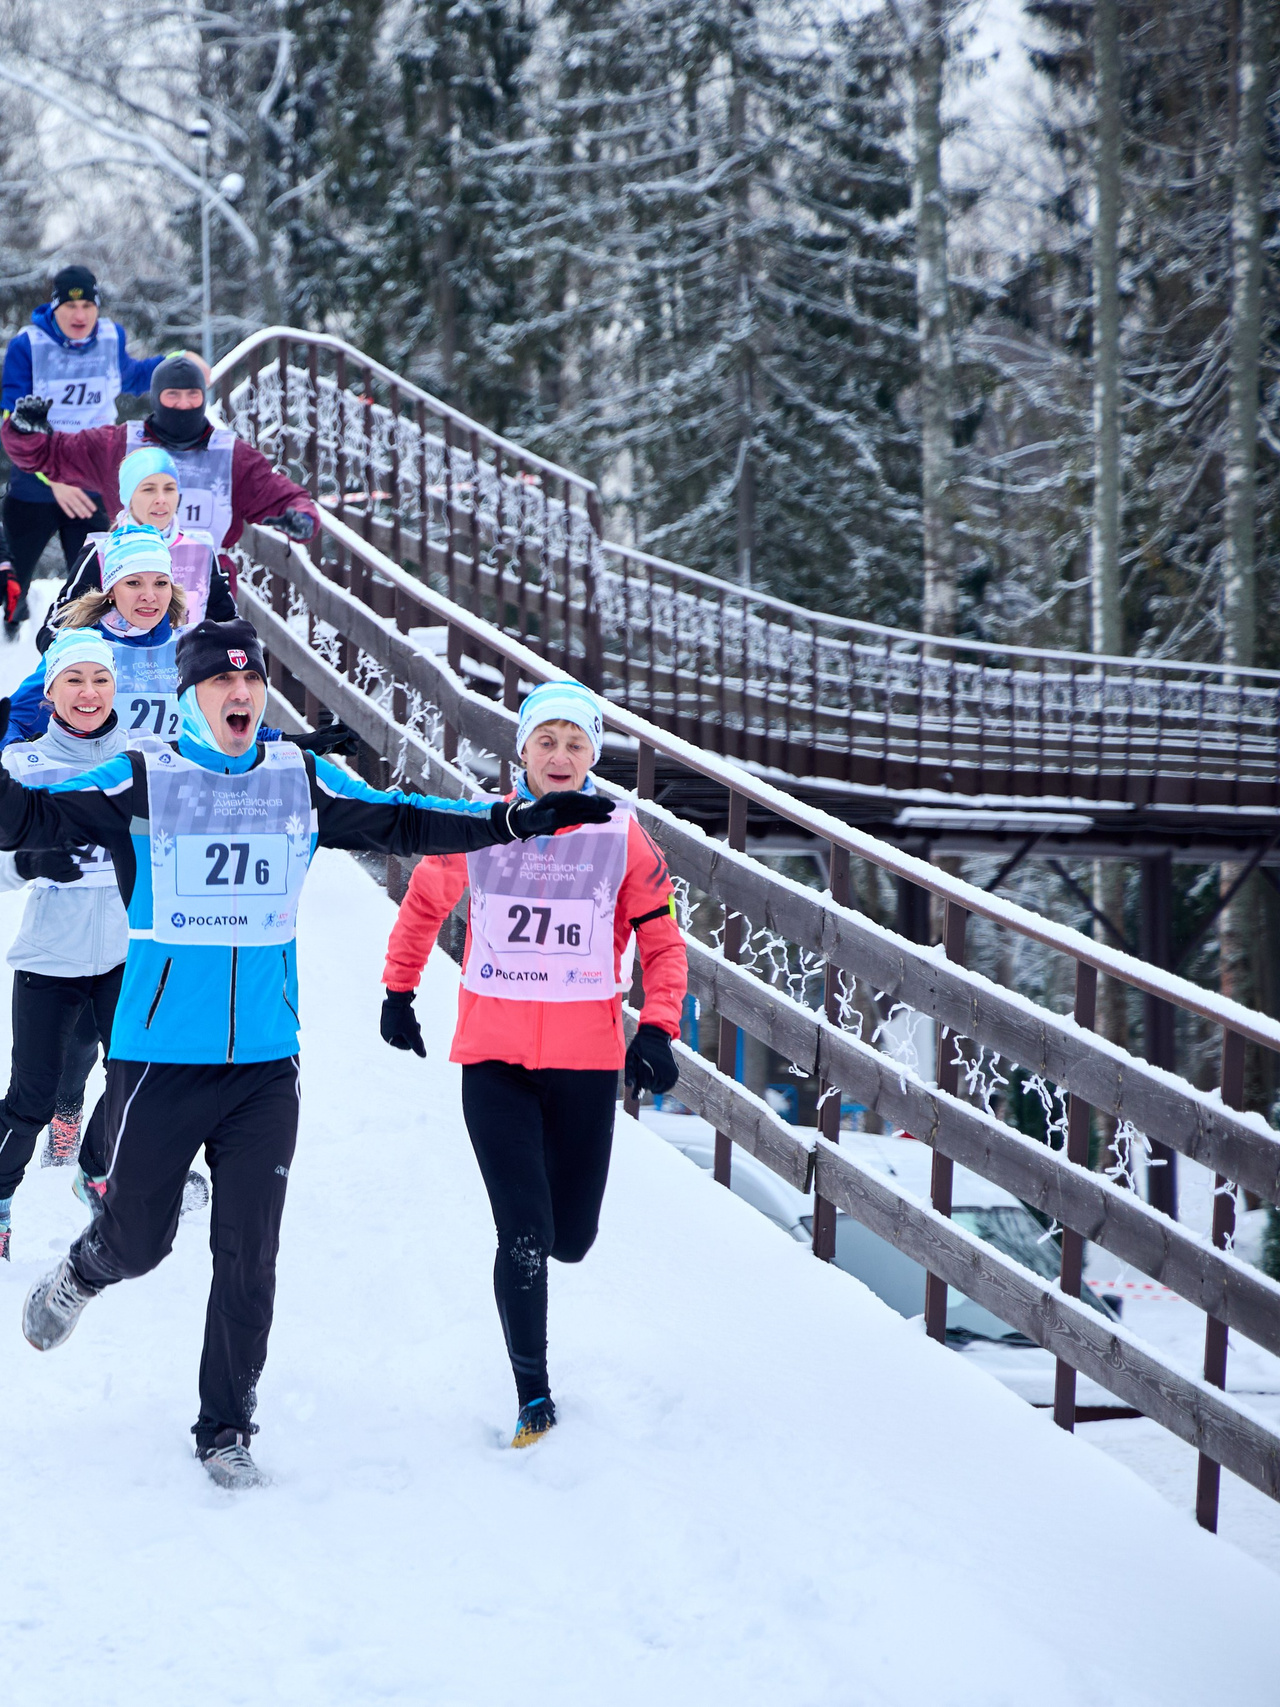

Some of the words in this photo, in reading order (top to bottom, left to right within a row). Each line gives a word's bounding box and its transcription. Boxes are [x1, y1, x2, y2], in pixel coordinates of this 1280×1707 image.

[61, 383, 87, 405] 27
[185, 504, 201, 522] 11
[132, 661, 159, 670] ГОНКА
[130, 699, 166, 735] 27
[168, 713, 179, 735] 2
[212, 790, 248, 799] ГОНКА
[213, 798, 283, 808] ДИВИЗИОНОВ
[214, 807, 268, 816] РОСАТОМА
[522, 852, 555, 862] ГОНКА
[205, 842, 250, 886] 27
[255, 859, 270, 885] 6
[521, 862, 594, 872] ДИВИЗИОНОВ
[521, 871, 576, 881] РОСАТОМА
[188, 915, 249, 926] РОСАТОМ
[508, 904, 551, 945] 27
[555, 923, 581, 947] 16
